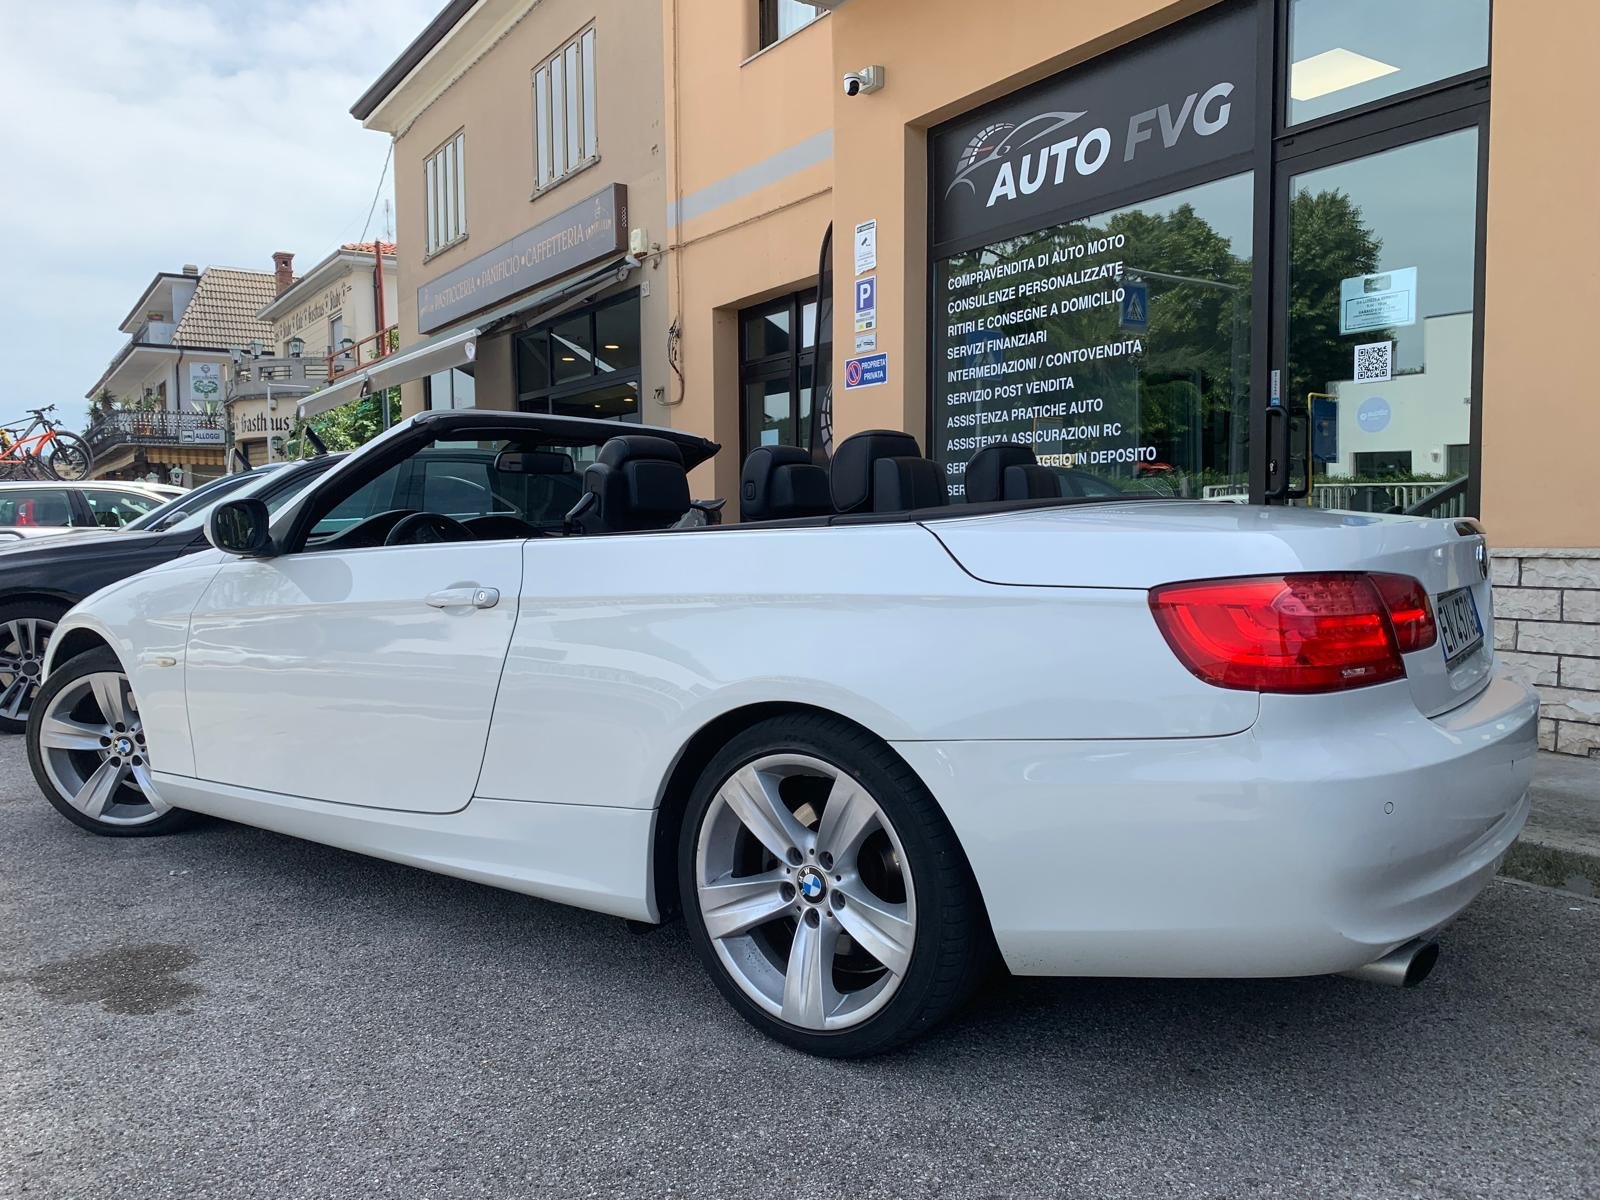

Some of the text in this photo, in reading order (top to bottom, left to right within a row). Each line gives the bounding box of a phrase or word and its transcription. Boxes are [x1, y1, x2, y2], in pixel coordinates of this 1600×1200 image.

[986, 82, 1235, 207] AUTO FVG
[433, 277, 475, 310] PASTICCERIA
[481, 256, 521, 288] PANIFICIO
[526, 223, 584, 267] CAFFETTERIA
[947, 234, 1125, 290] COMPRAVENDITA DI AUTO MOTO
[859, 283, 871, 309] P
[947, 261, 1124, 314] CONSULENZE PERSONALIZZATE
[947, 288, 1125, 337] RITIRI E CONSEGNE A DOMICILIO
[947, 330, 1047, 359] SERVIZI FINANZIARI
[947, 359, 1037, 383] INTERMEDIAZIONI
[1046, 339, 1142, 367] CONTOVENDITA
[863, 371, 884, 381] PRIVATA
[947, 377, 1074, 405] SERVIZIO POST VENDITA
[947, 398, 1103, 428] ASSISTENZA PRATICHE AUTO
[195, 432, 220, 440] ALLOGGI
[1011, 425, 1100, 444] ASSICURAZIONI
[1104, 423, 1122, 437] RC
[1075, 452, 1087, 465] IN
[1090, 447, 1157, 465] DEPOSITO
